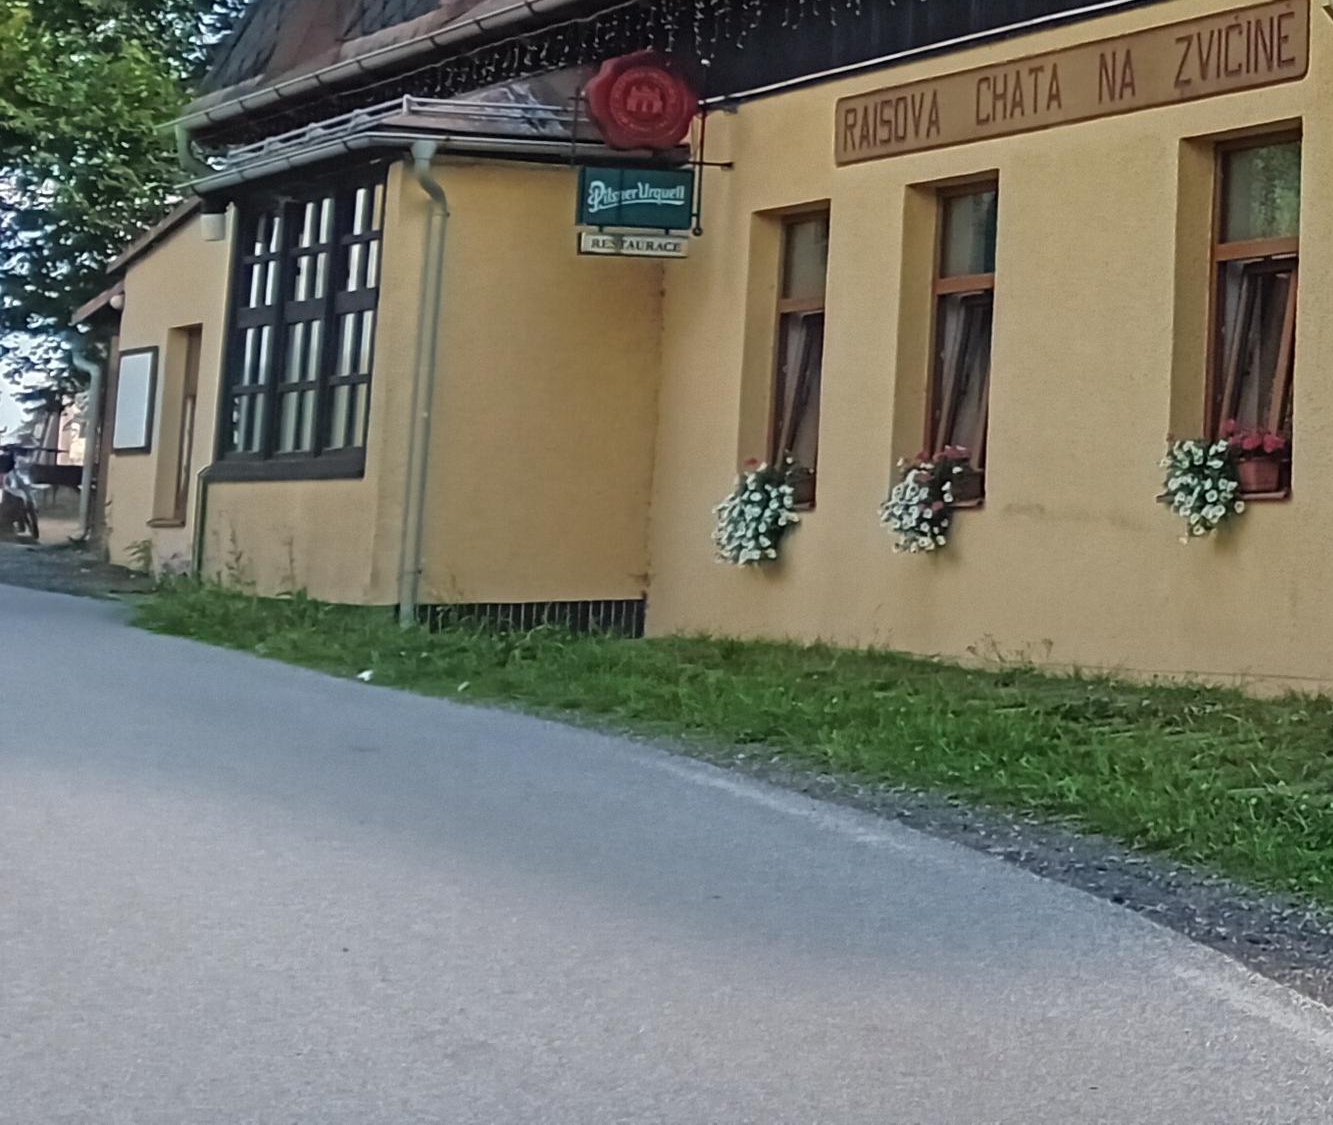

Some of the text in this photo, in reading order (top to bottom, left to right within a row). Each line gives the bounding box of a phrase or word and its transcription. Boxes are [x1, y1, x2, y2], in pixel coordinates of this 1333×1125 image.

[843, 89, 941, 153] RAISOVA
[975, 63, 1062, 126] CHATA
[1099, 48, 1136, 105] NA
[637, 182, 685, 205] Urquell
